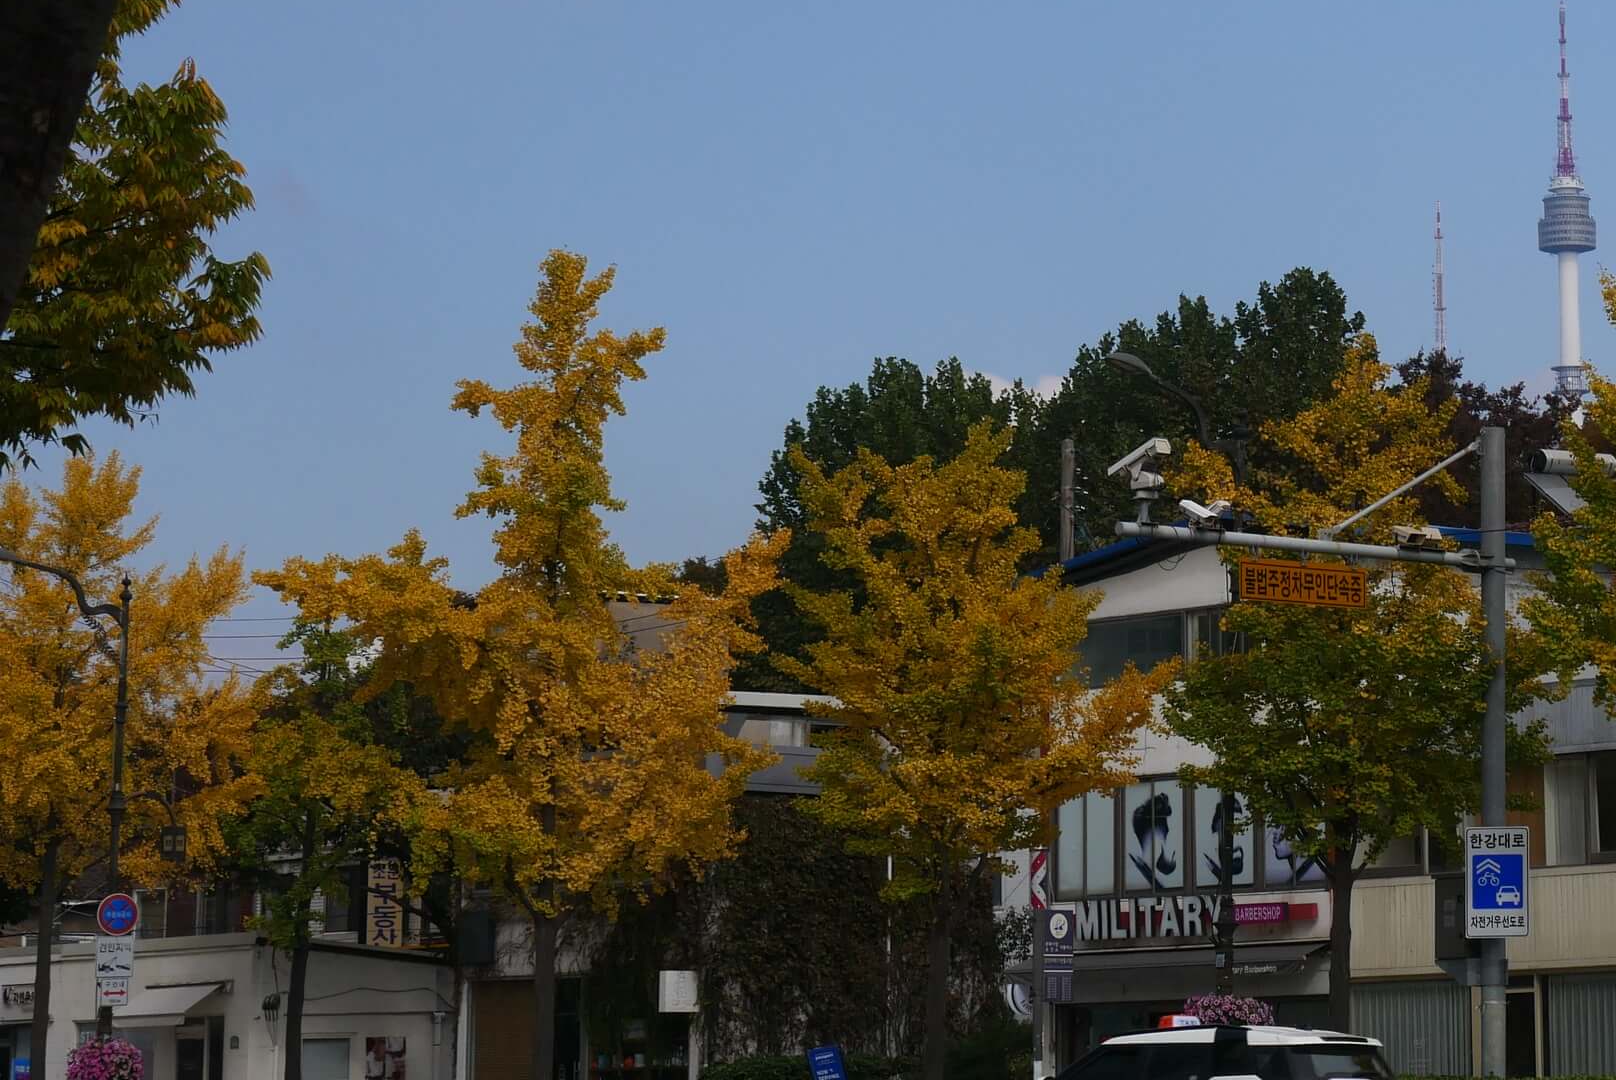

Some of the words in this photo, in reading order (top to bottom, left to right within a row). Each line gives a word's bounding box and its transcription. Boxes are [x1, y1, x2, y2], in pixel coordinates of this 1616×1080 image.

[1244, 567, 1361, 603] 불법주정차무인단속중
[1470, 833, 1526, 849] 한강대로
[1075, 895, 1222, 941] MILITARY
[1235, 905, 1281, 922] BARBERSHOP
[1470, 915, 1525, 929] 자전거우선도로
